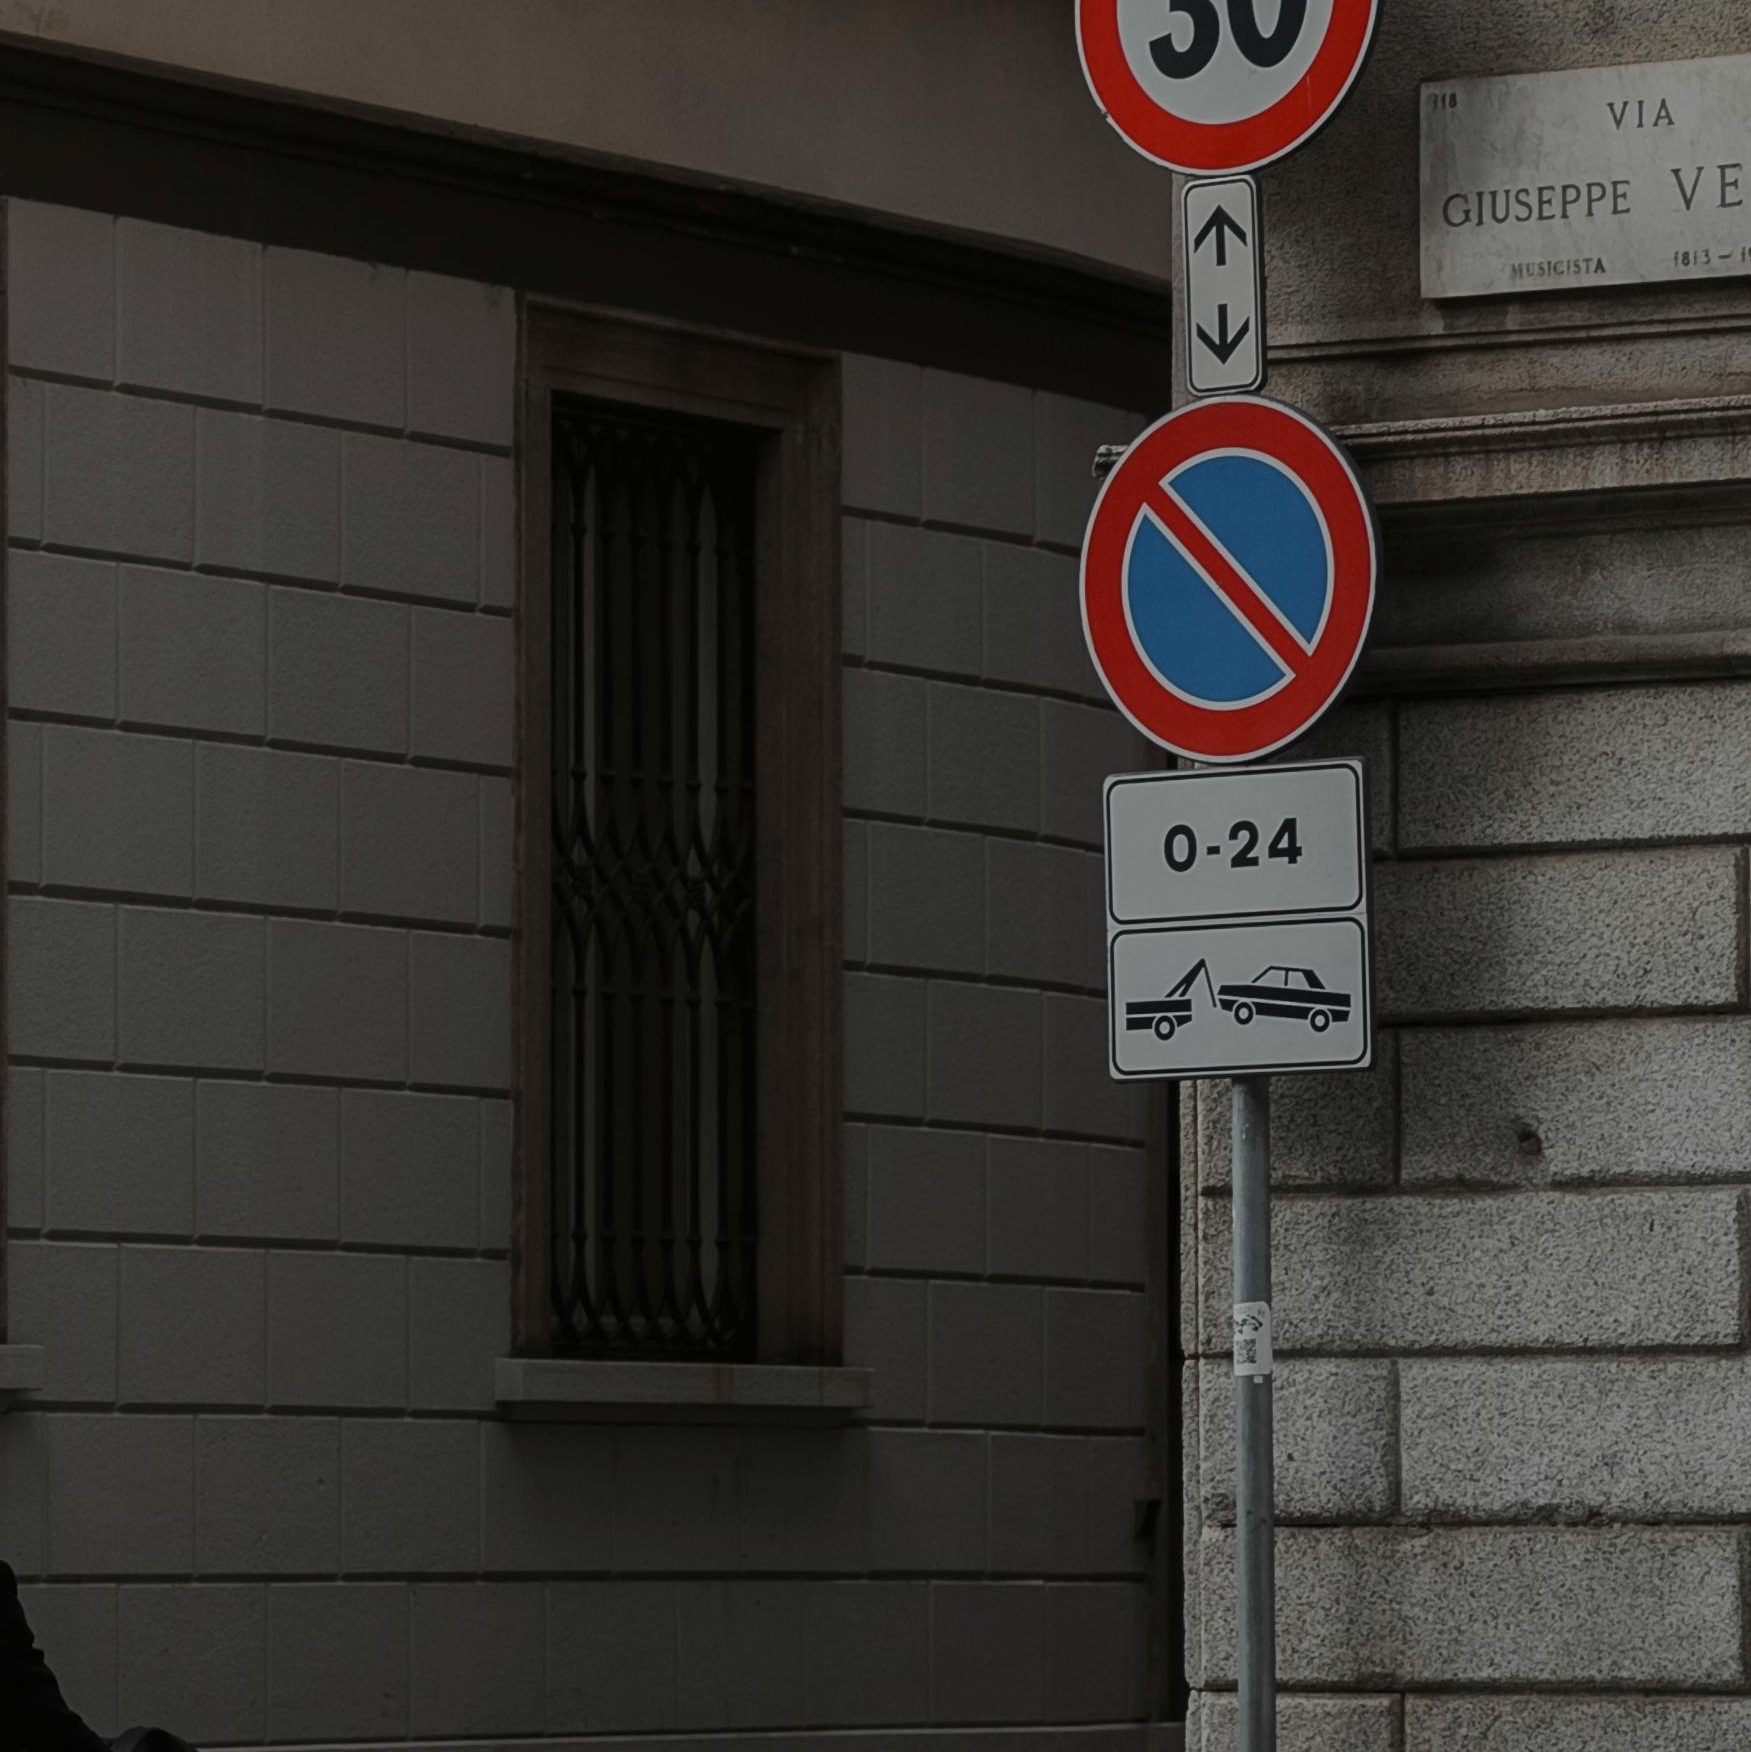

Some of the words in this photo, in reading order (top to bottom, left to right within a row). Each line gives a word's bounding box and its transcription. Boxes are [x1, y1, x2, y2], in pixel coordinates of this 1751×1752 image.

[1607, 98, 1676, 130] VIA
[1442, 180, 1632, 228] GIUSEPPE
[1670, 163, 1744, 212] VE
[1510, 257, 1606, 280] MUSICISTA
[1164, 817, 1303, 873] 0-24
